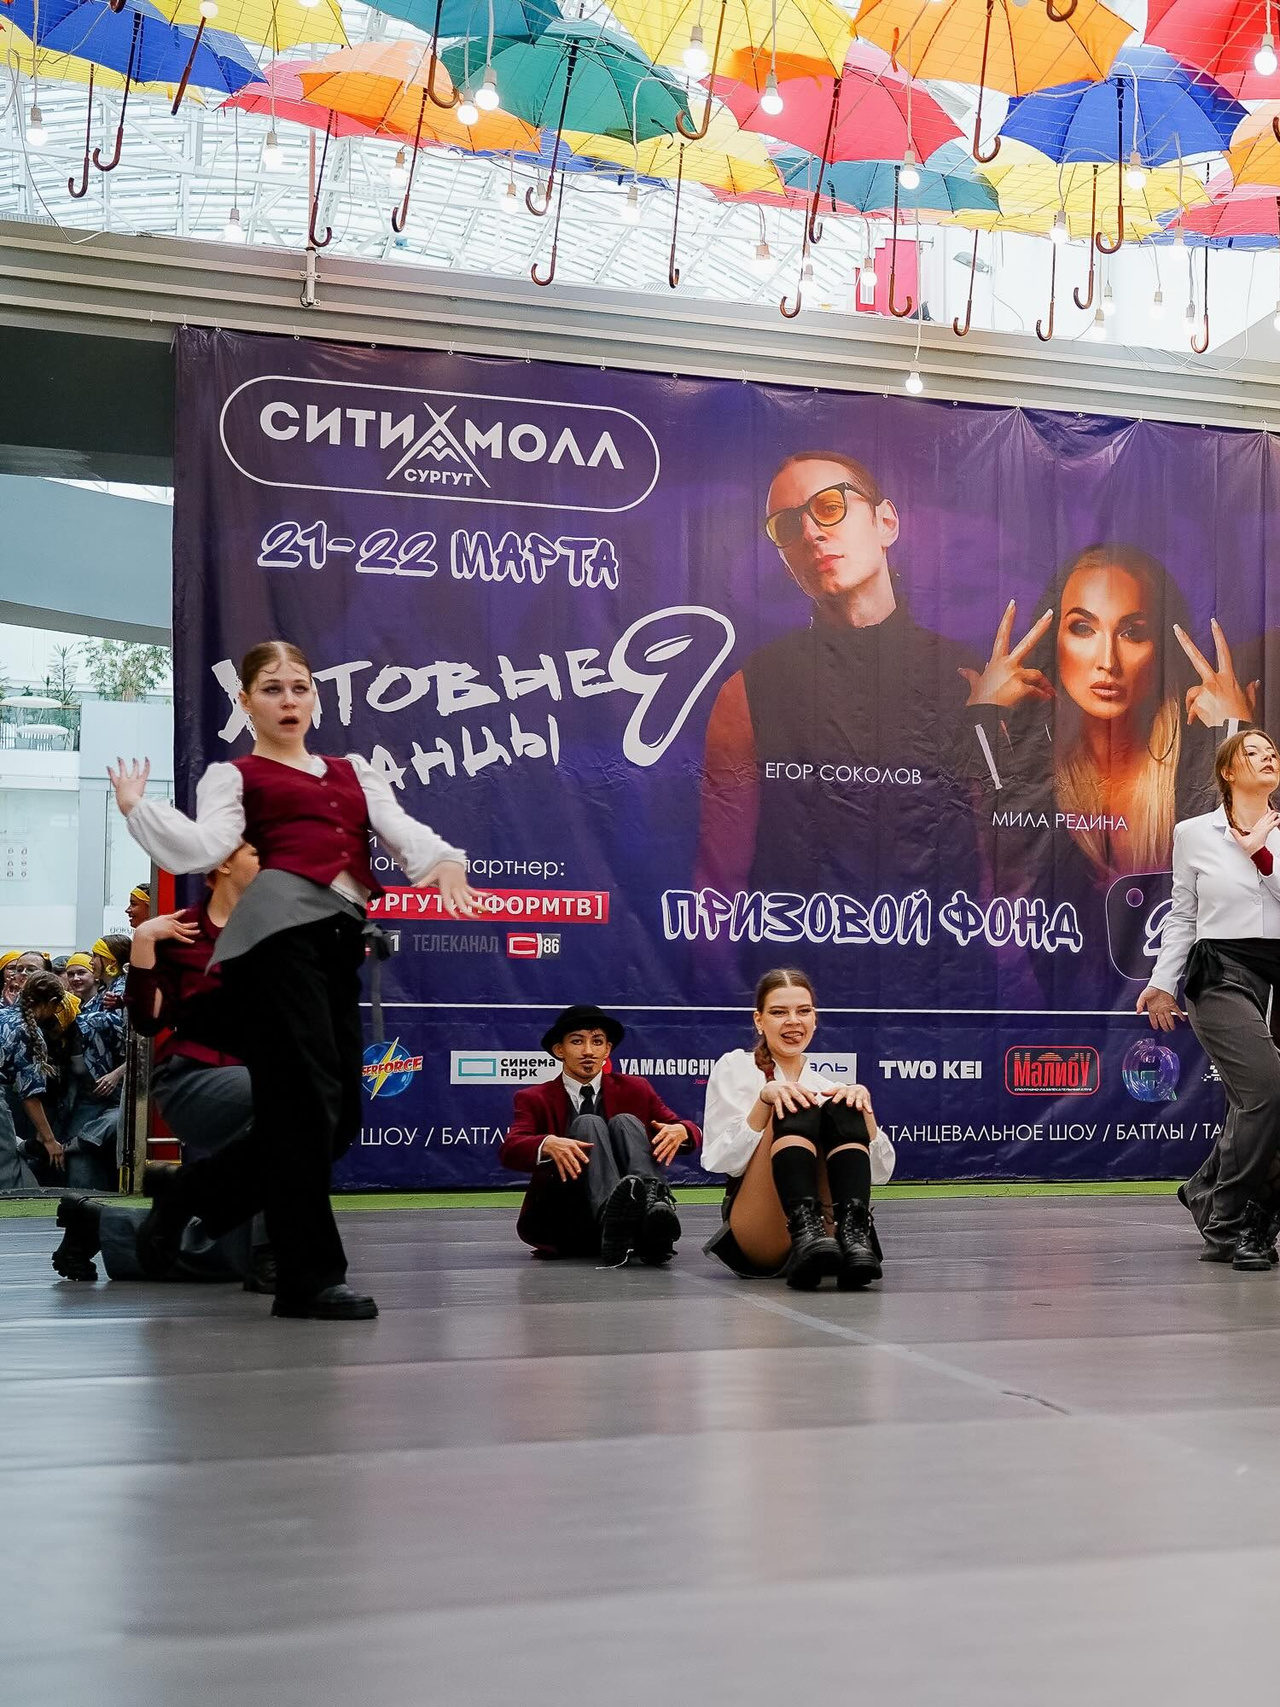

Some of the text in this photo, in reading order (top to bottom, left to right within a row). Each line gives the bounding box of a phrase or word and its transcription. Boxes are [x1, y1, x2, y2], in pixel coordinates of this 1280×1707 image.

[259, 401, 625, 470] СИТИ МОЛЛ
[404, 468, 473, 487] СУРГУТ
[257, 520, 619, 590] 21-22 МАРТА
[211, 648, 619, 744] ХТОВЫЕ
[370, 713, 560, 790] АНЦЫ
[765, 762, 922, 785] ЕГОР СОКОЛОВ
[991, 811, 1128, 831] МИЛА РЕДИНА
[369, 893, 603, 920] УРГУТФОРМТВ]
[661, 888, 931, 945] ПРИЗОВОЙ
[939, 890, 1083, 953] ФОНД
[413, 933, 499, 953] ТЕЛЕКАНАЛ
[362, 1056, 423, 1077] SERFORCE
[500, 1058, 556, 1067] синема
[879, 1060, 982, 1079] TWO KEI
[500, 1068, 538, 1080] парк
[361, 1128, 418, 1145] ШОУ
[442, 1127, 511, 1145] БАТТЛ
[889, 1124, 1043, 1144] ТАНЦЕВАЛЬНОЕ
[1050, 1124, 1097, 1141] ШОУ
[1116, 1124, 1184, 1140] БАТТЛЫ
